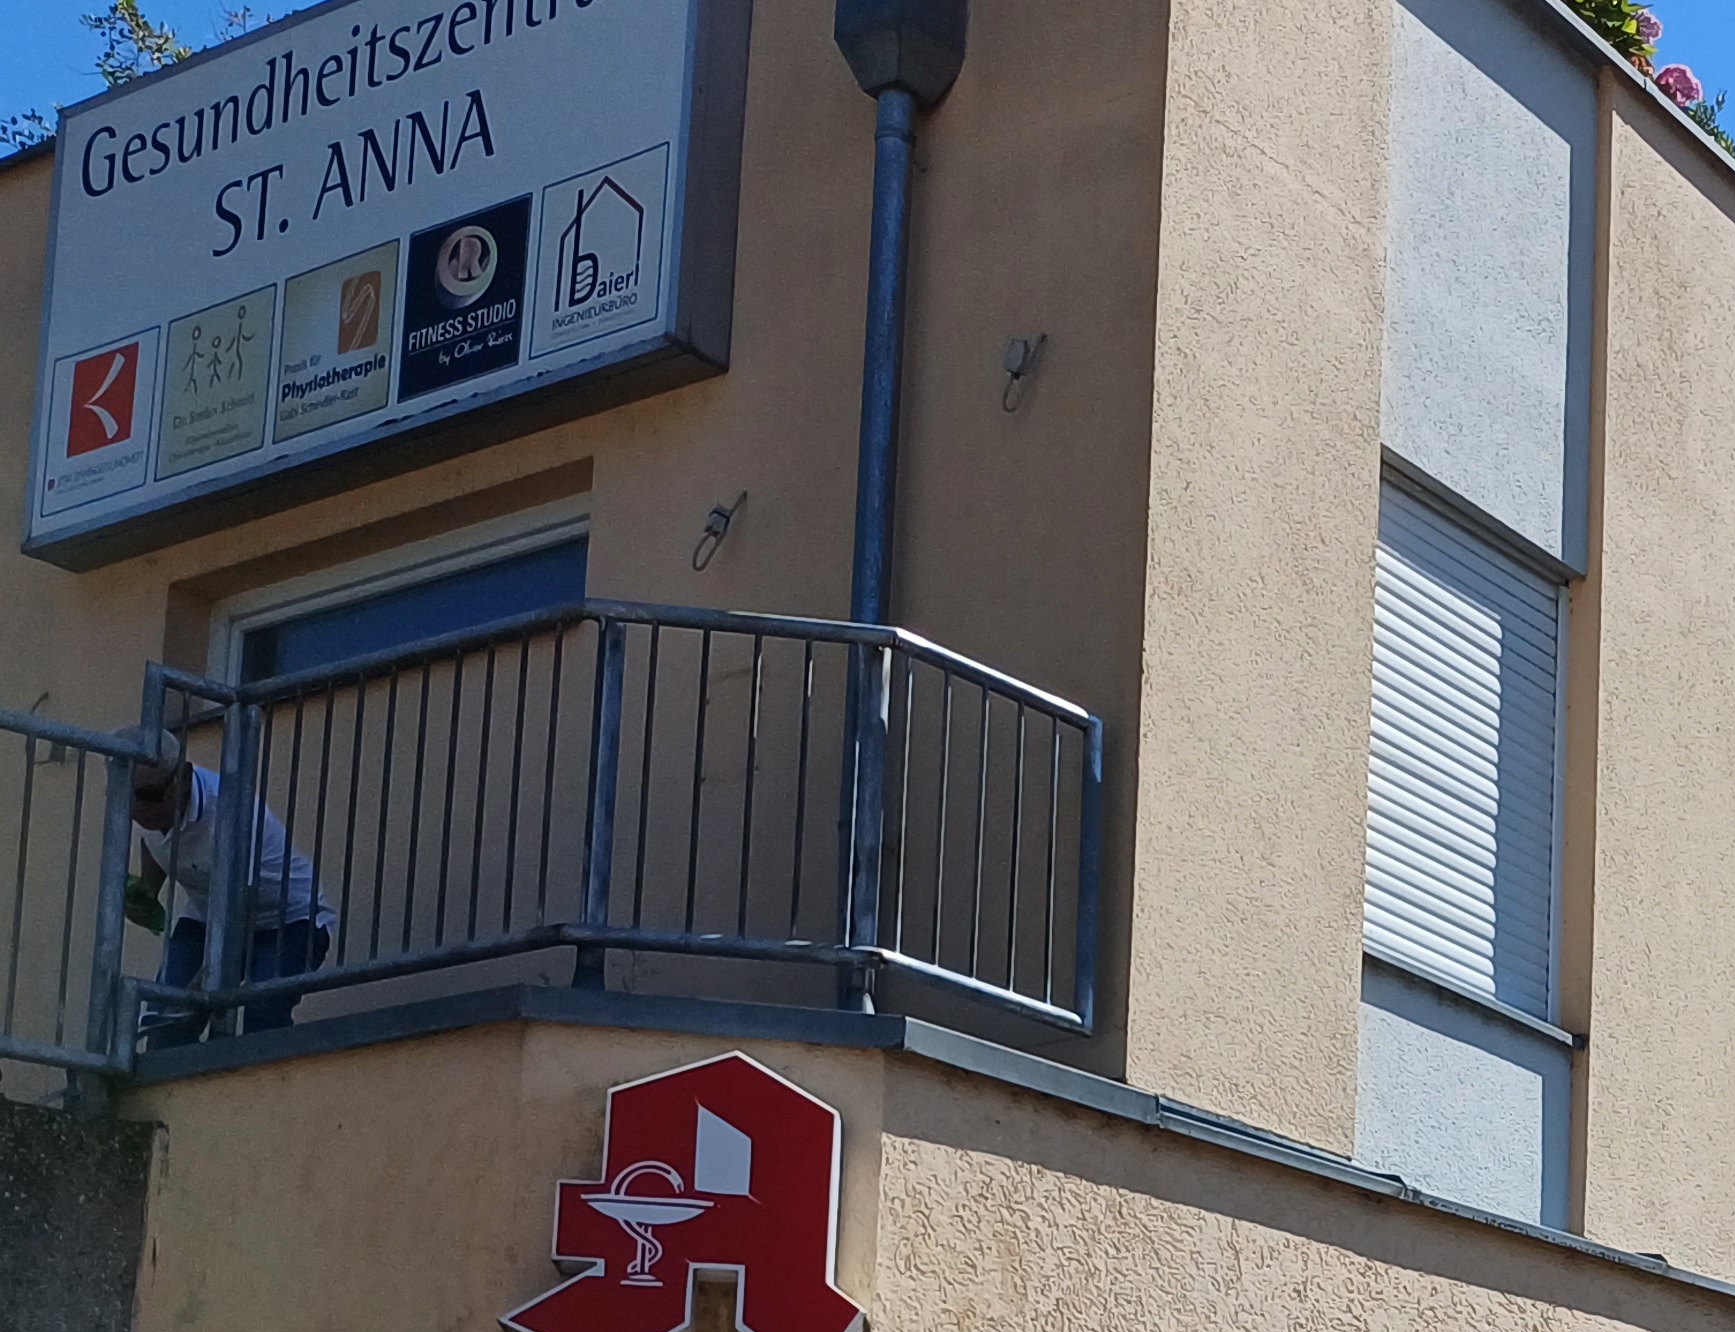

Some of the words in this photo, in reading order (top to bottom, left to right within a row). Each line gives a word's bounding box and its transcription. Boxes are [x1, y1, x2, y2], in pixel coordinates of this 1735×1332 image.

[80, 0, 599, 198] Gesundheitszen
[211, 163, 291, 258] ST.
[312, 88, 496, 221] ANNA
[407, 316, 463, 352] FITNESS
[466, 298, 517, 332] STUDIO
